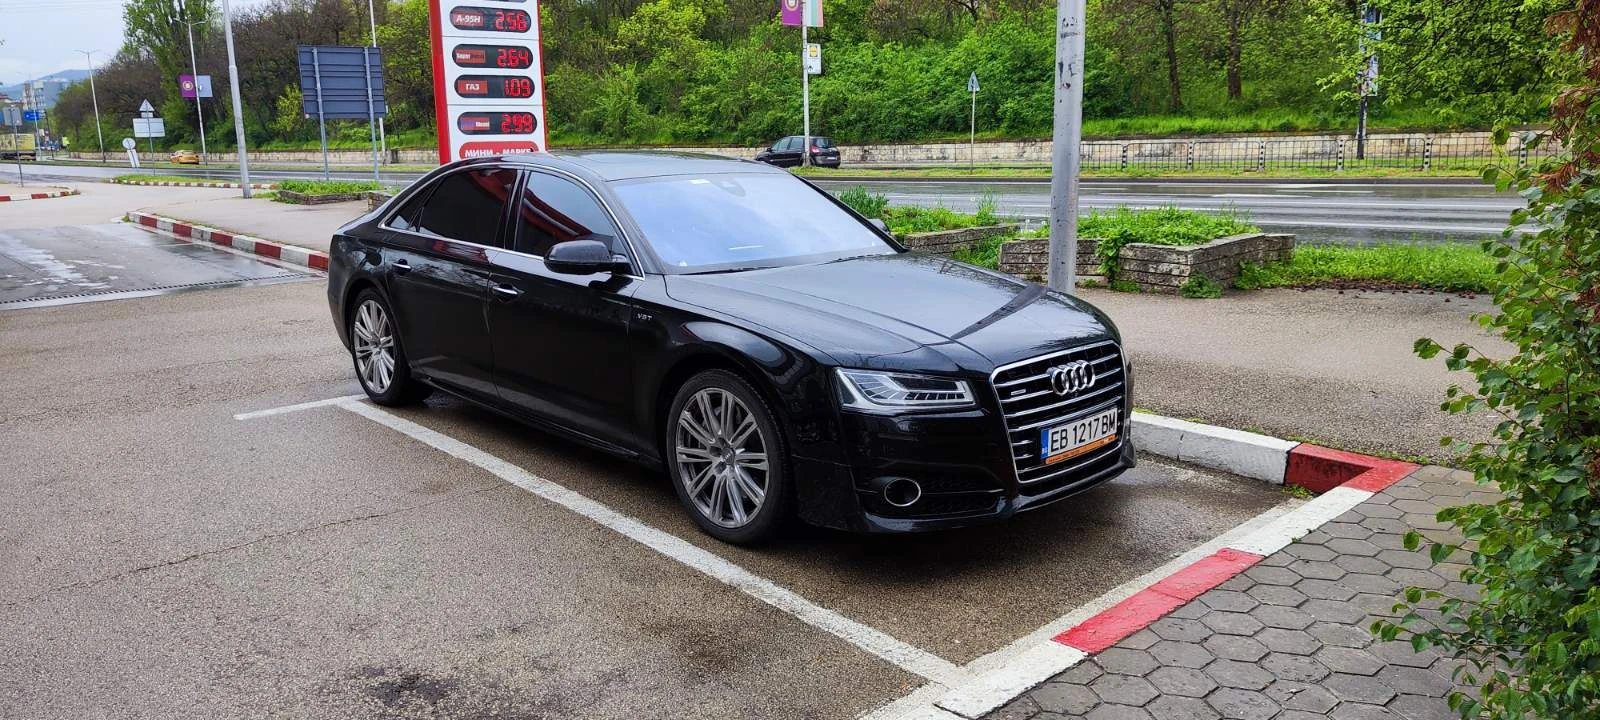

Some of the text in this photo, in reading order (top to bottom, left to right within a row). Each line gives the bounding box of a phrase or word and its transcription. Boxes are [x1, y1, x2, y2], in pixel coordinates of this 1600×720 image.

[465, 83, 480, 91] ГАЗ
[464, 149, 494, 158] МИНИ
[1050, 429, 1069, 452] EB
[1072, 418, 1100, 445] 1217
[1101, 411, 1116, 434] BM
